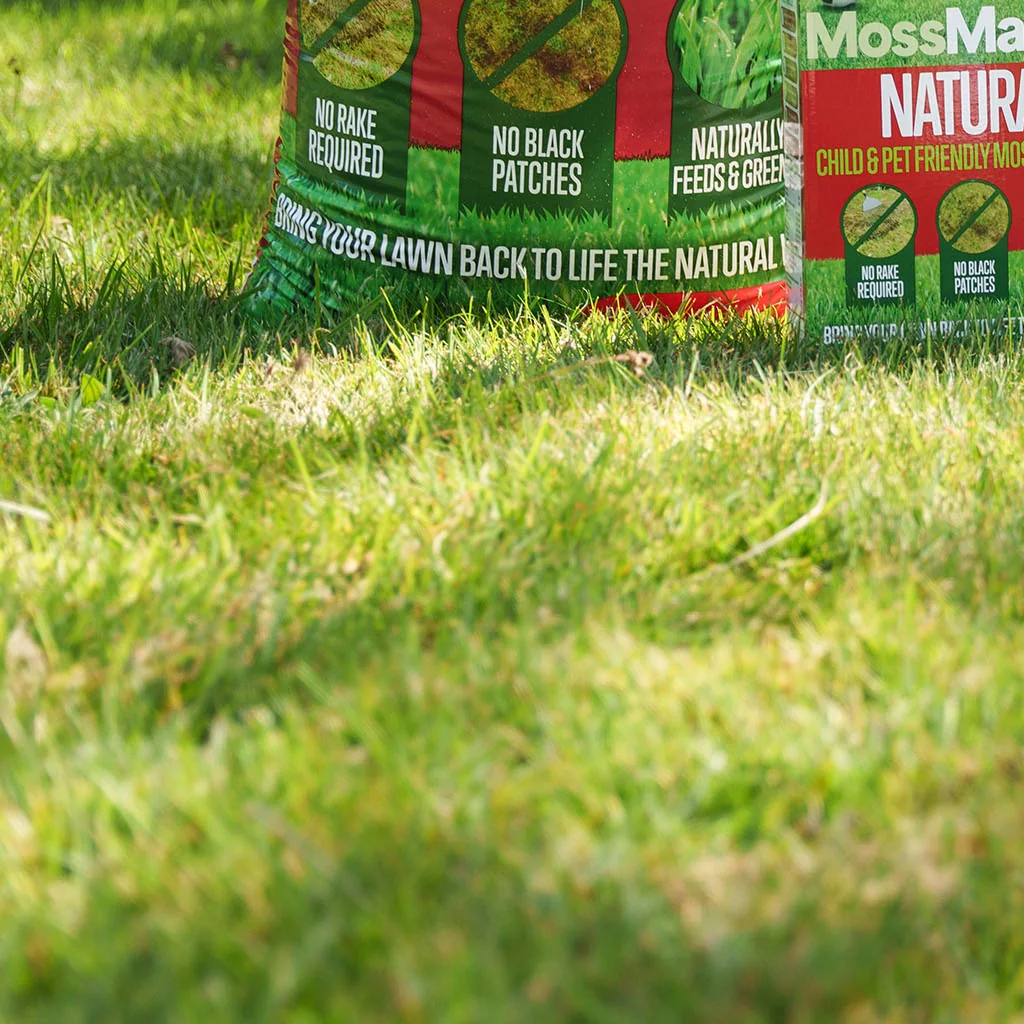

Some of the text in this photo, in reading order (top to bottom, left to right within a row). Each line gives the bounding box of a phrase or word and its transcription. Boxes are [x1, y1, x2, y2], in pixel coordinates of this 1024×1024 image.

[315, 97, 377, 140] NO RAKE
[308, 128, 384, 179] REQUIRED
[492, 125, 584, 159] NO BLACK
[691, 118, 784, 161] NATURALLY
[816, 147, 863, 176] CHILD
[866, 146, 879, 174] &
[882, 146, 912, 174] PET
[914, 142, 990, 173] FRIENDLY
[492, 158, 582, 196] PATCHES
[673, 162, 726, 195] FEEDS
[728, 161, 740, 191] &
[274, 193, 323, 245] BRING
[322, 216, 377, 263] YOUR
[380, 233, 453, 276] LAWN
[460, 244, 527, 279] BACK
[532, 247, 562, 280] TO
[569, 249, 618, 281] LIFE
[623, 248, 670, 280] THE
[675, 236, 778, 280] NATURAL
[861, 264, 899, 281] NO RAKE
[953, 259, 996, 276] NO BLACK
[857, 280, 904, 301] REQUIRED
[954, 275, 996, 295] PATCHES
